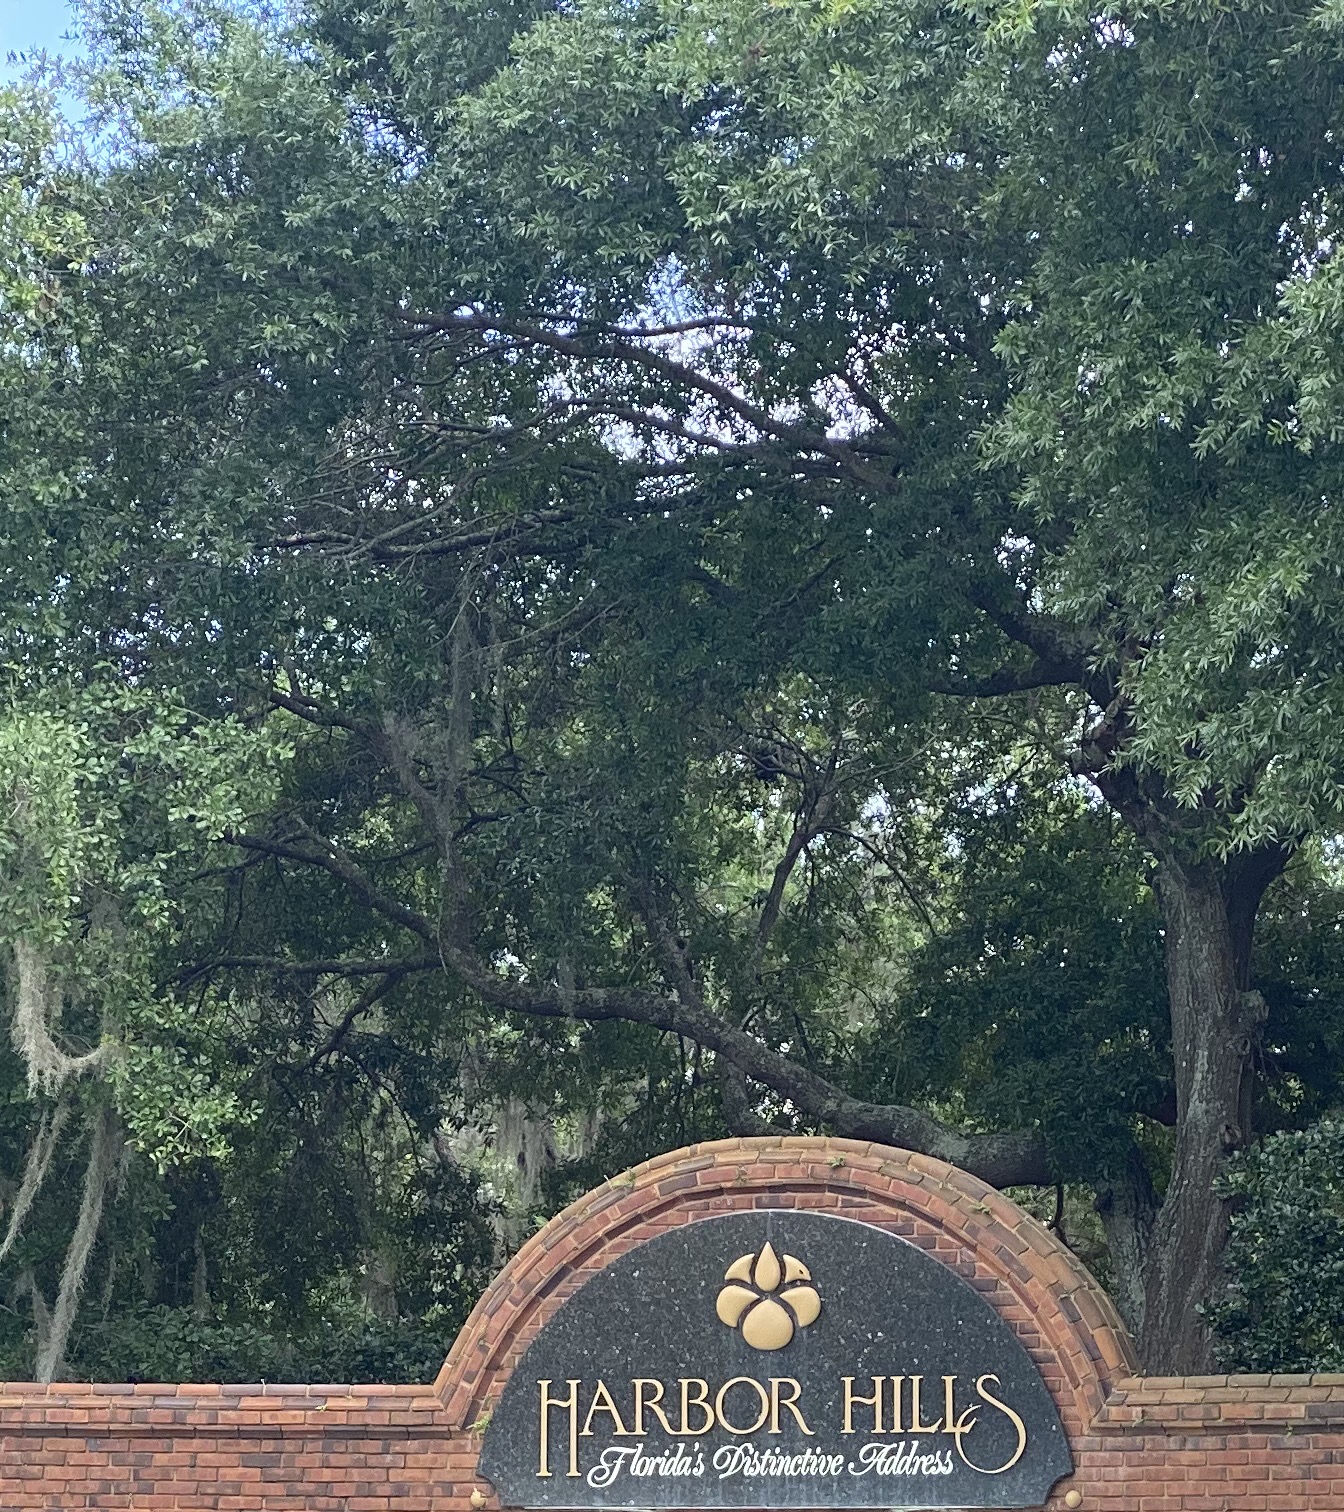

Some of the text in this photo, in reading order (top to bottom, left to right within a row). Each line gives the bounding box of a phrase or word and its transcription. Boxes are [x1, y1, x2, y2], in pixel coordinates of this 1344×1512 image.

[536, 1373, 1027, 1477] HARBOR HILLS
[587, 1440, 954, 1488] Florida's Distinctive Address
